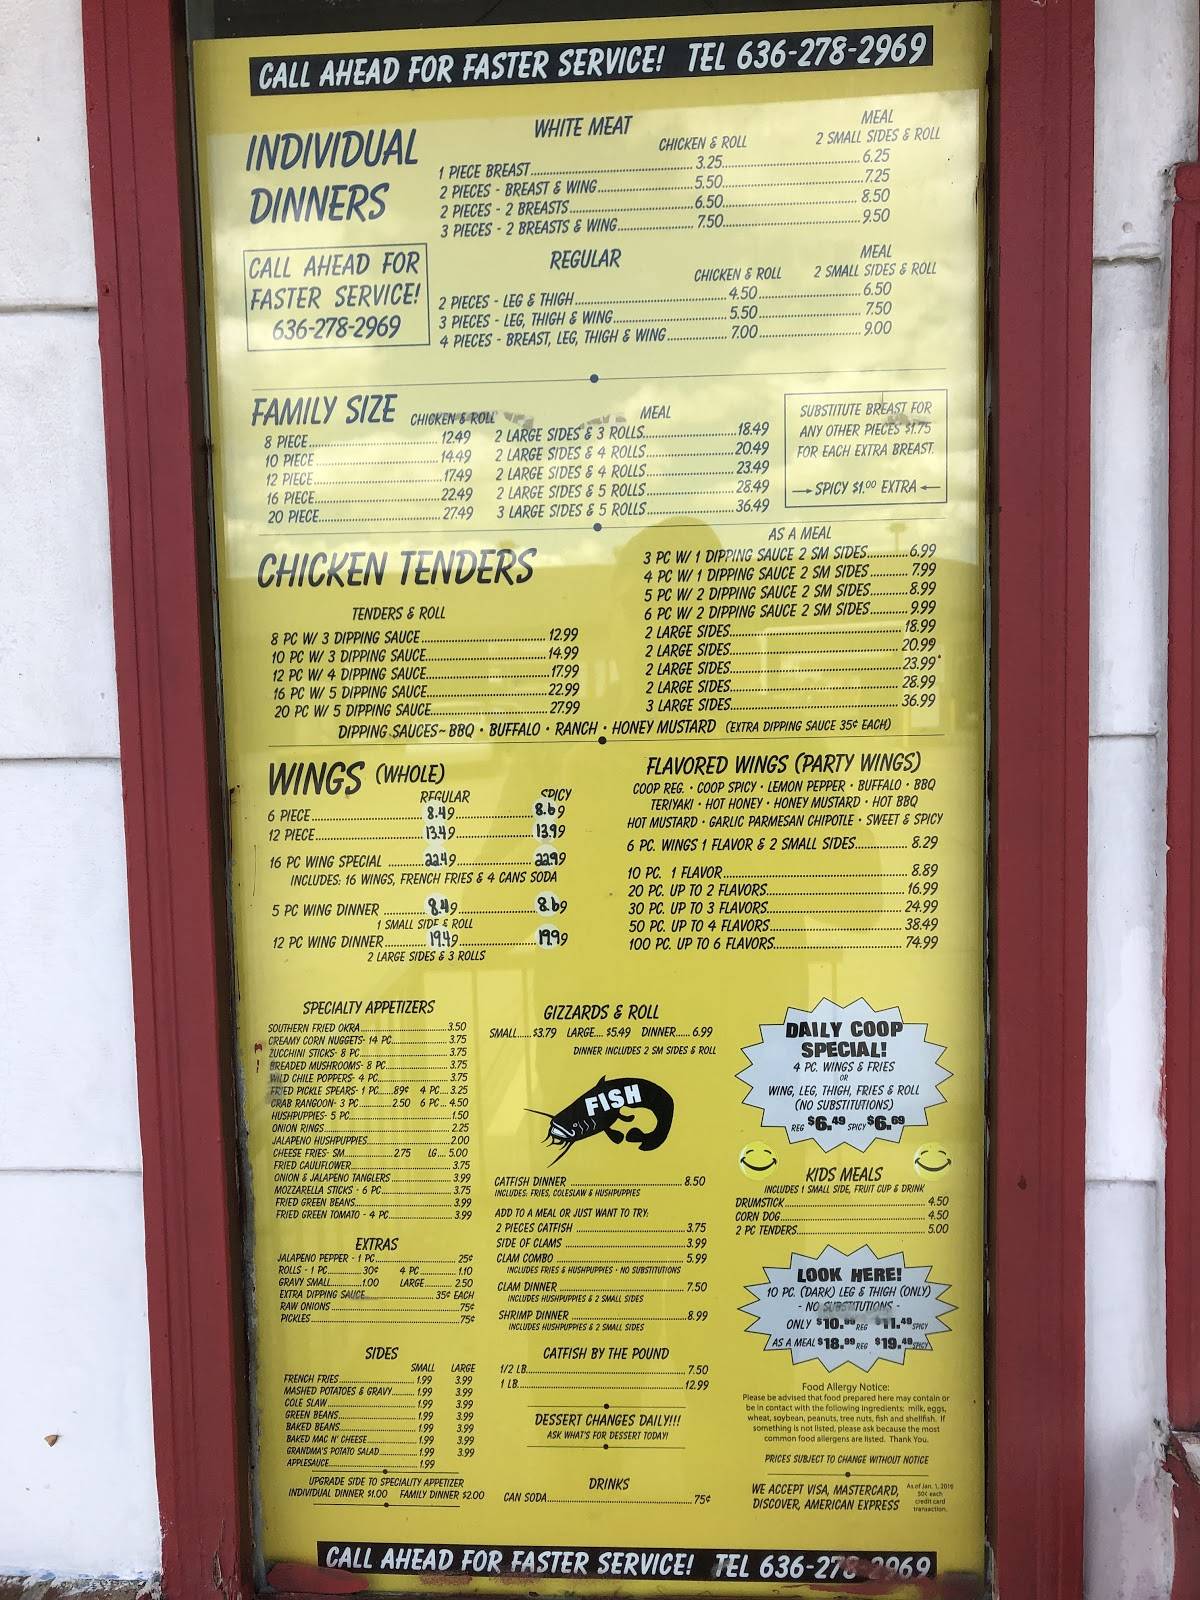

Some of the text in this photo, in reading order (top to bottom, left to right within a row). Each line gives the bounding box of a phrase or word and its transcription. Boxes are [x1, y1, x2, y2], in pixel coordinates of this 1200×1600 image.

[259, 32, 927, 90] CALL AHEAD FOR FASTER SERVICE! TEL 636-278-2969
[861, 109, 893, 125] MEAL
[535, 115, 633, 138] WHITE MEAT
[658, 135, 747, 151] CHICKEN & ROLL
[815, 126, 940, 145] 2 SMALL SIDES & ROLL
[862, 148, 891, 163] 6.25
[246, 128, 418, 224] INDIVIDUAL DINNERS
[550, 248, 622, 270] REGULAR
[860, 244, 892, 259] MEAL
[249, 251, 420, 279] CALL AHEAD FOR
[250, 282, 421, 311] FASTER SERVICE!
[866, 301, 892, 315] 7.50
[273, 315, 401, 340] 636-278-2969
[864, 320, 892, 337] 9.00
[251, 394, 398, 427] FAMILY SIZE
[640, 405, 671, 420] MEAL
[800, 401, 932, 418] SUBSTITUTE BREAST FOR
[738, 421, 770, 437] 18.49
[799, 419, 932, 438] ANY OTHER PIECES $1.75
[797, 441, 935, 458] FOR EACH EXTRA BREAST.
[815, 481, 849, 496] SPICY
[881, 479, 916, 494] EXTRA
[736, 498, 770, 513] 36.49
[768, 525, 832, 541] AS A MEAL
[257, 548, 537, 588] CHICKEN TENDERS
[352, 606, 446, 621] TENDERS & ROLL
[489, 719, 717, 737] BUFFALO RANCH HONEY MUSTARD
[646, 751, 921, 776] FLAVORED WINGS (PARTY WINGS)
[269, 761, 445, 796] WINGS (WHOLE)
[633, 778, 936, 795] COOP REG. COOP SPICY LEMON PEPPER BUFFALO BBQ
[911, 835, 939, 850] 8.29
[290, 871, 557, 887] INCLUDES: 16 WINGS, FRENCH FRIES & 4 CANS SODA
[904, 899, 939, 914] 24.99
[906, 935, 939, 950] 74.99
[303, 1000, 436, 1015] SPECIALTY APPETIZERS
[544, 1004, 659, 1021] GIZZARDS & ROLL
[268, 1023, 360, 1034] SOUTHERN FRIED OKRA
[447, 1021, 467, 1032] 3.50
[785, 1020, 903, 1038] DAILY COOP
[801, 1041, 887, 1058] SPECIAL!
[585, 1084, 642, 1119] FISH
[274, 1172, 391, 1183] ONION & JALAPENO TANGLERS
[805, 1166, 884, 1183] KIDS MEALS
[355, 1237, 399, 1251] EXTRAS
[797, 1267, 902, 1283] LOOK HERE!
[365, 1346, 399, 1360] SIDES
[543, 1347, 670, 1360] CATFISH BY THE POUND
[411, 1363, 435, 1372] SMALL
[451, 1363, 476, 1373] LARGE
[802, 1382, 890, 1394] Food Allergy Notice:
[535, 1413, 681, 1427] DESSERT CHANGES DAILY!!!
[798, 1434, 816, 1443] food
[817, 1434, 850, 1444] allergens
[864, 1435, 886, 1443] listed.
[889, 1435, 912, 1443] Thank
[912, 1435, 929, 1444] You.
[764, 1454, 929, 1465] PRICES SUBJECT TO CHANGE WITHOUT NOTICE
[589, 1477, 630, 1491] DRINKS
[752, 1483, 899, 1498] WE ACCEPT VISA, MASTERCARD,
[326, 1546, 749, 1578] CALL AHEAD FOR FASTER SERVICE! TEL
